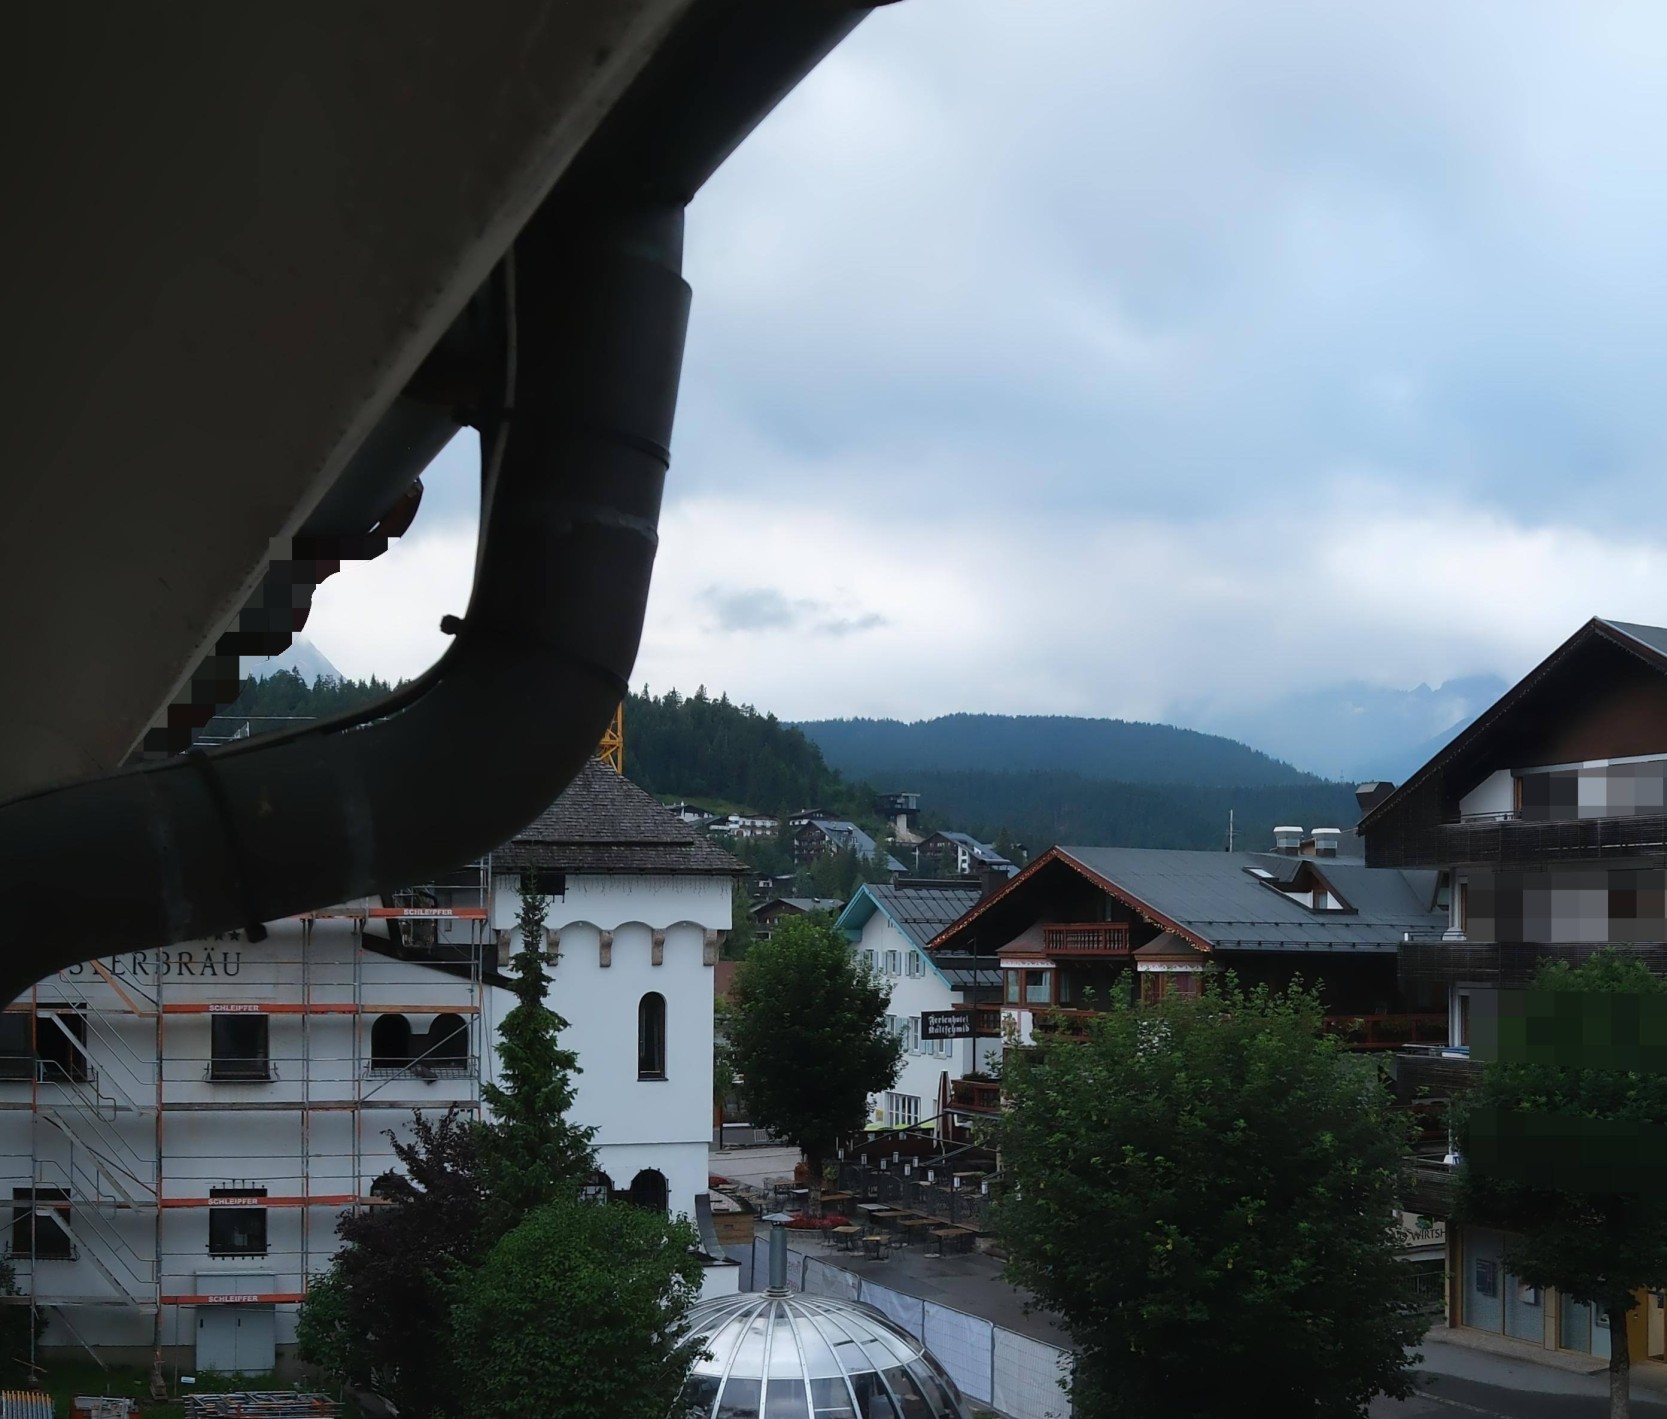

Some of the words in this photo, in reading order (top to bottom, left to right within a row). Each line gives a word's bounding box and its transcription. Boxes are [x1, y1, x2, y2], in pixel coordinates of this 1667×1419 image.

[403, 908, 453, 916] SCHLEIPFER
[69, 946, 242, 978] SERBRÄU
[209, 1004, 259, 1012] SCHLEIPFER
[208, 1198, 258, 1206] SCHLEIPFER
[208, 1295, 258, 1303] SCHLEIPFER
